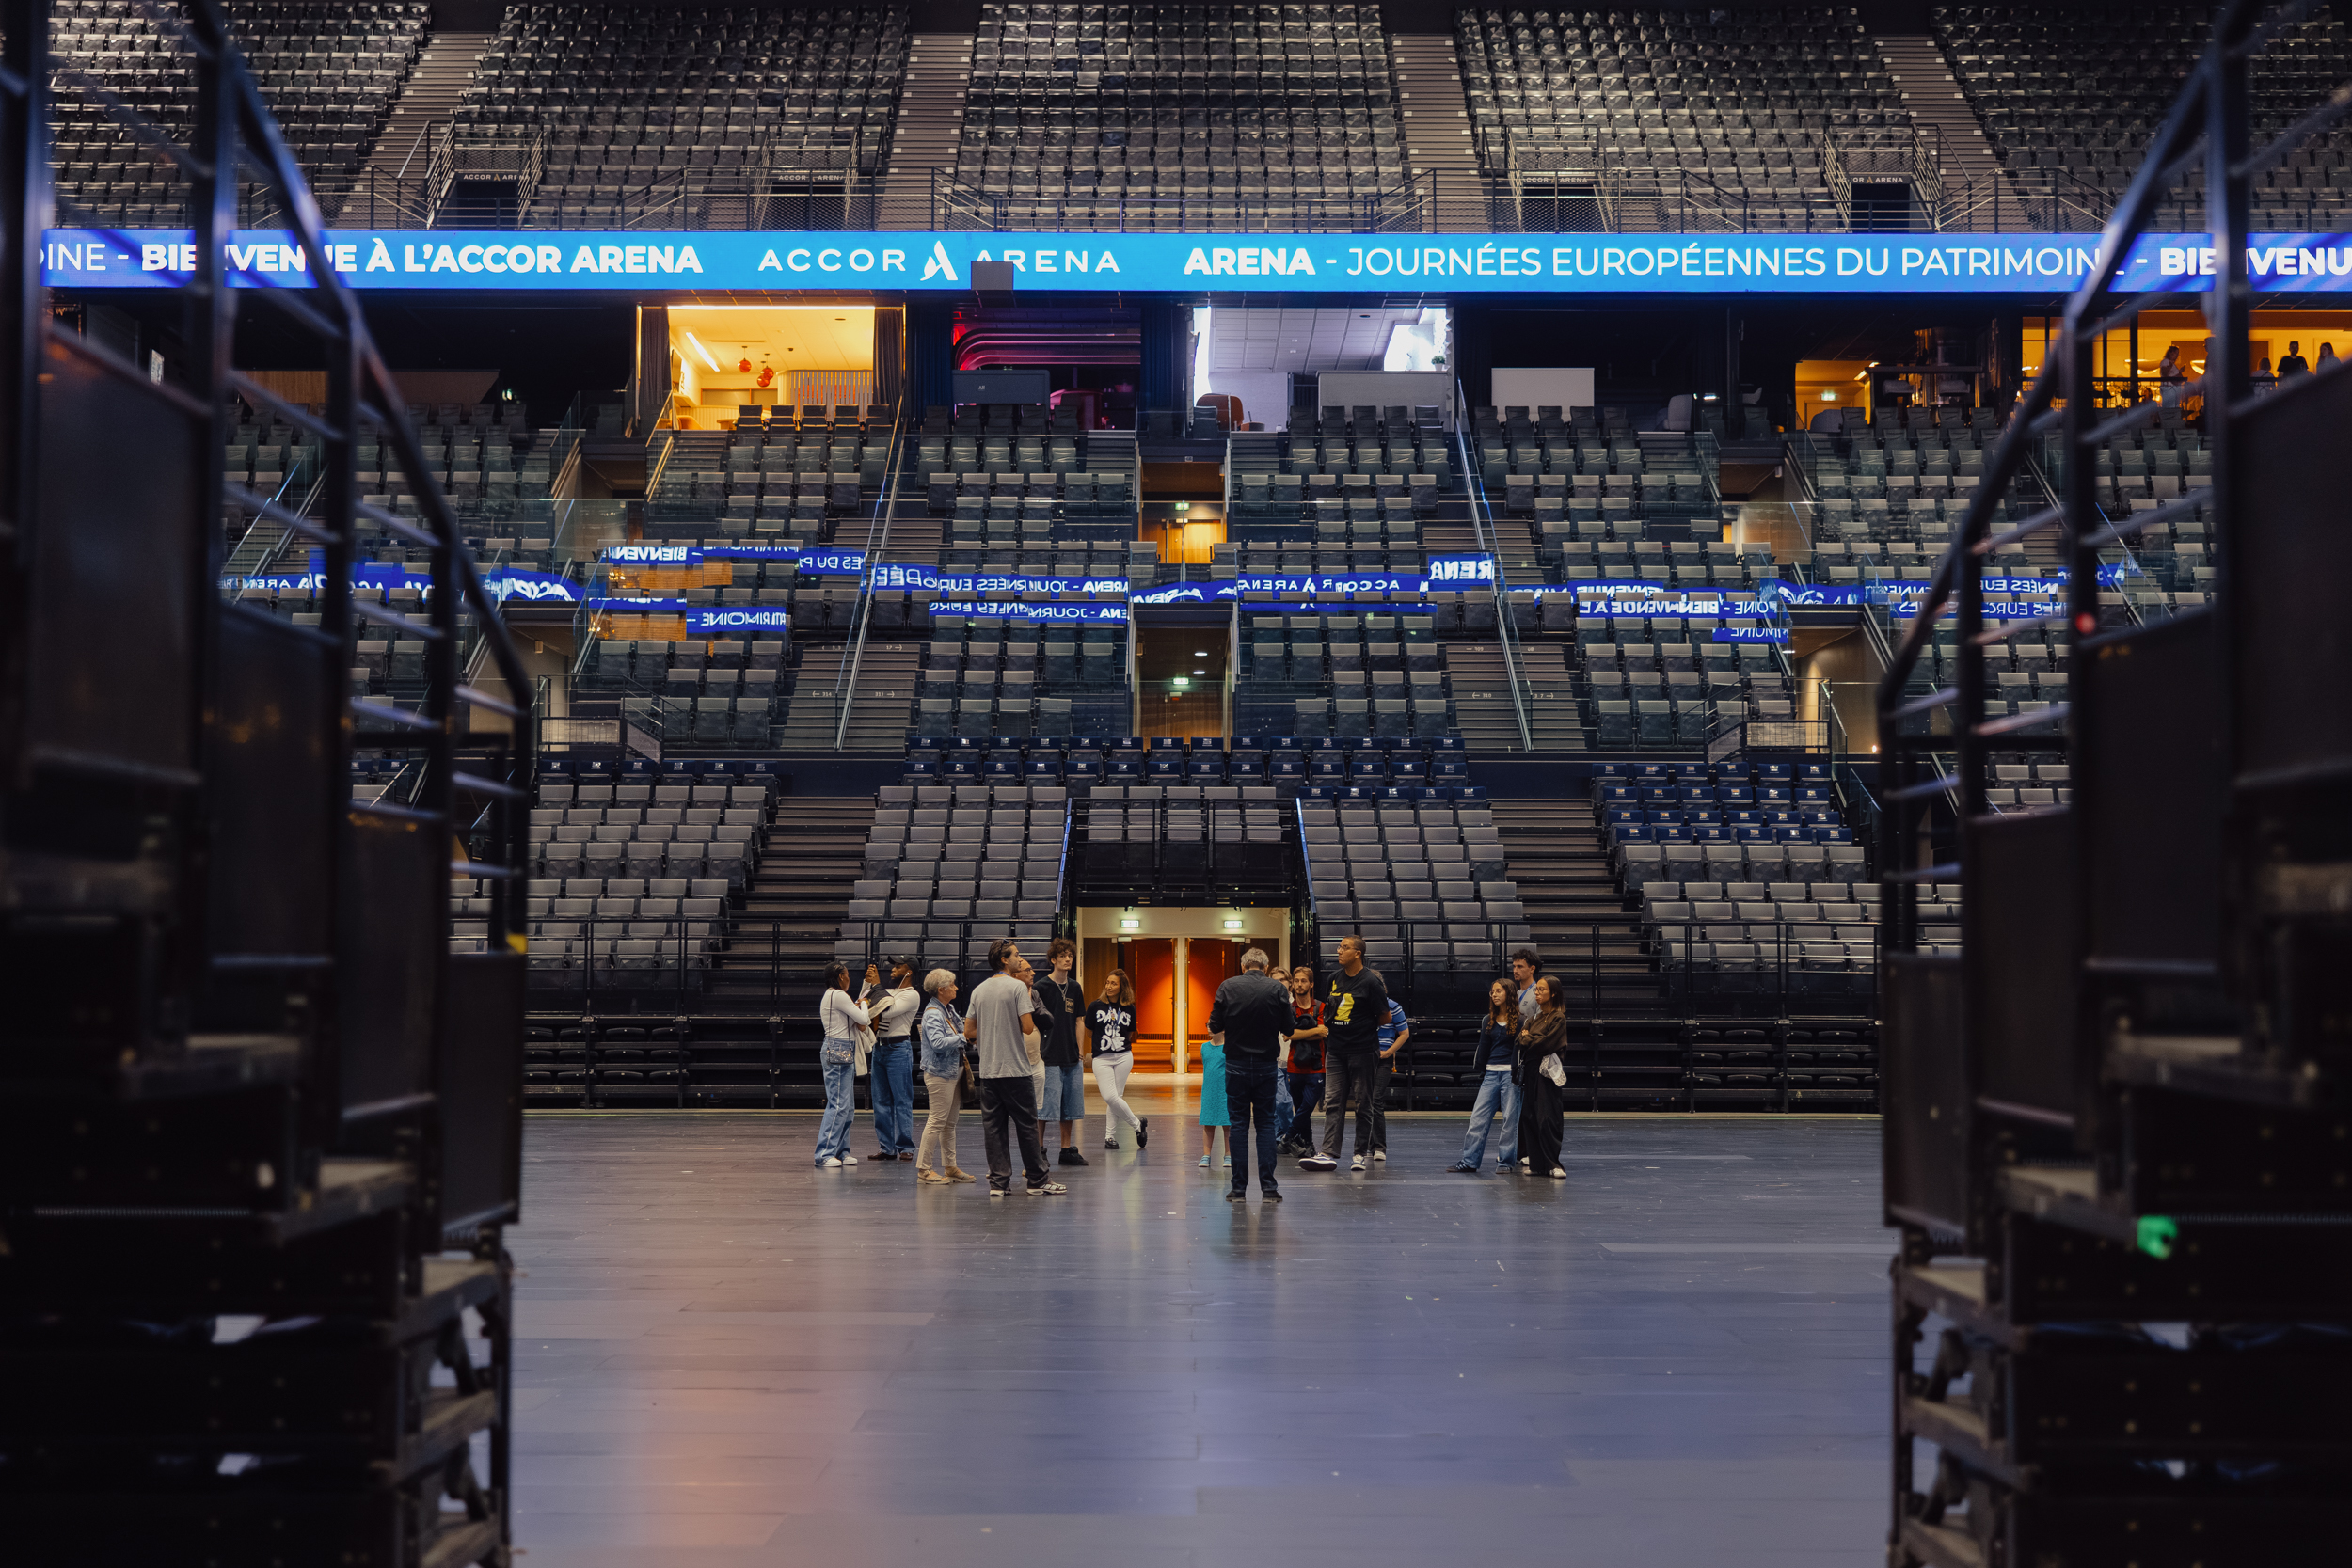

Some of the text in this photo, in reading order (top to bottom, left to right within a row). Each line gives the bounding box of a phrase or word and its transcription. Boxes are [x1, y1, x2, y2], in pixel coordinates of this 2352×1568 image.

[40, 243, 106, 271] INE
[141, 243, 358, 272] BIEVENE
[366, 237, 395, 272] À
[405, 243, 562, 274] L'ACCOR
[569, 245, 704, 274] ARENA
[757, 248, 906, 273] ACCOR
[1184, 247, 1317, 276] ARENA
[1346, 241, 1542, 276] JOURNÉES
[1552, 242, 1827, 276] EUROPÉENNES
[1836, 247, 1890, 276] DU
[1901, 247, 2125, 276] PATRIMOIN
[2160, 247, 2352, 276] BIEVENU
